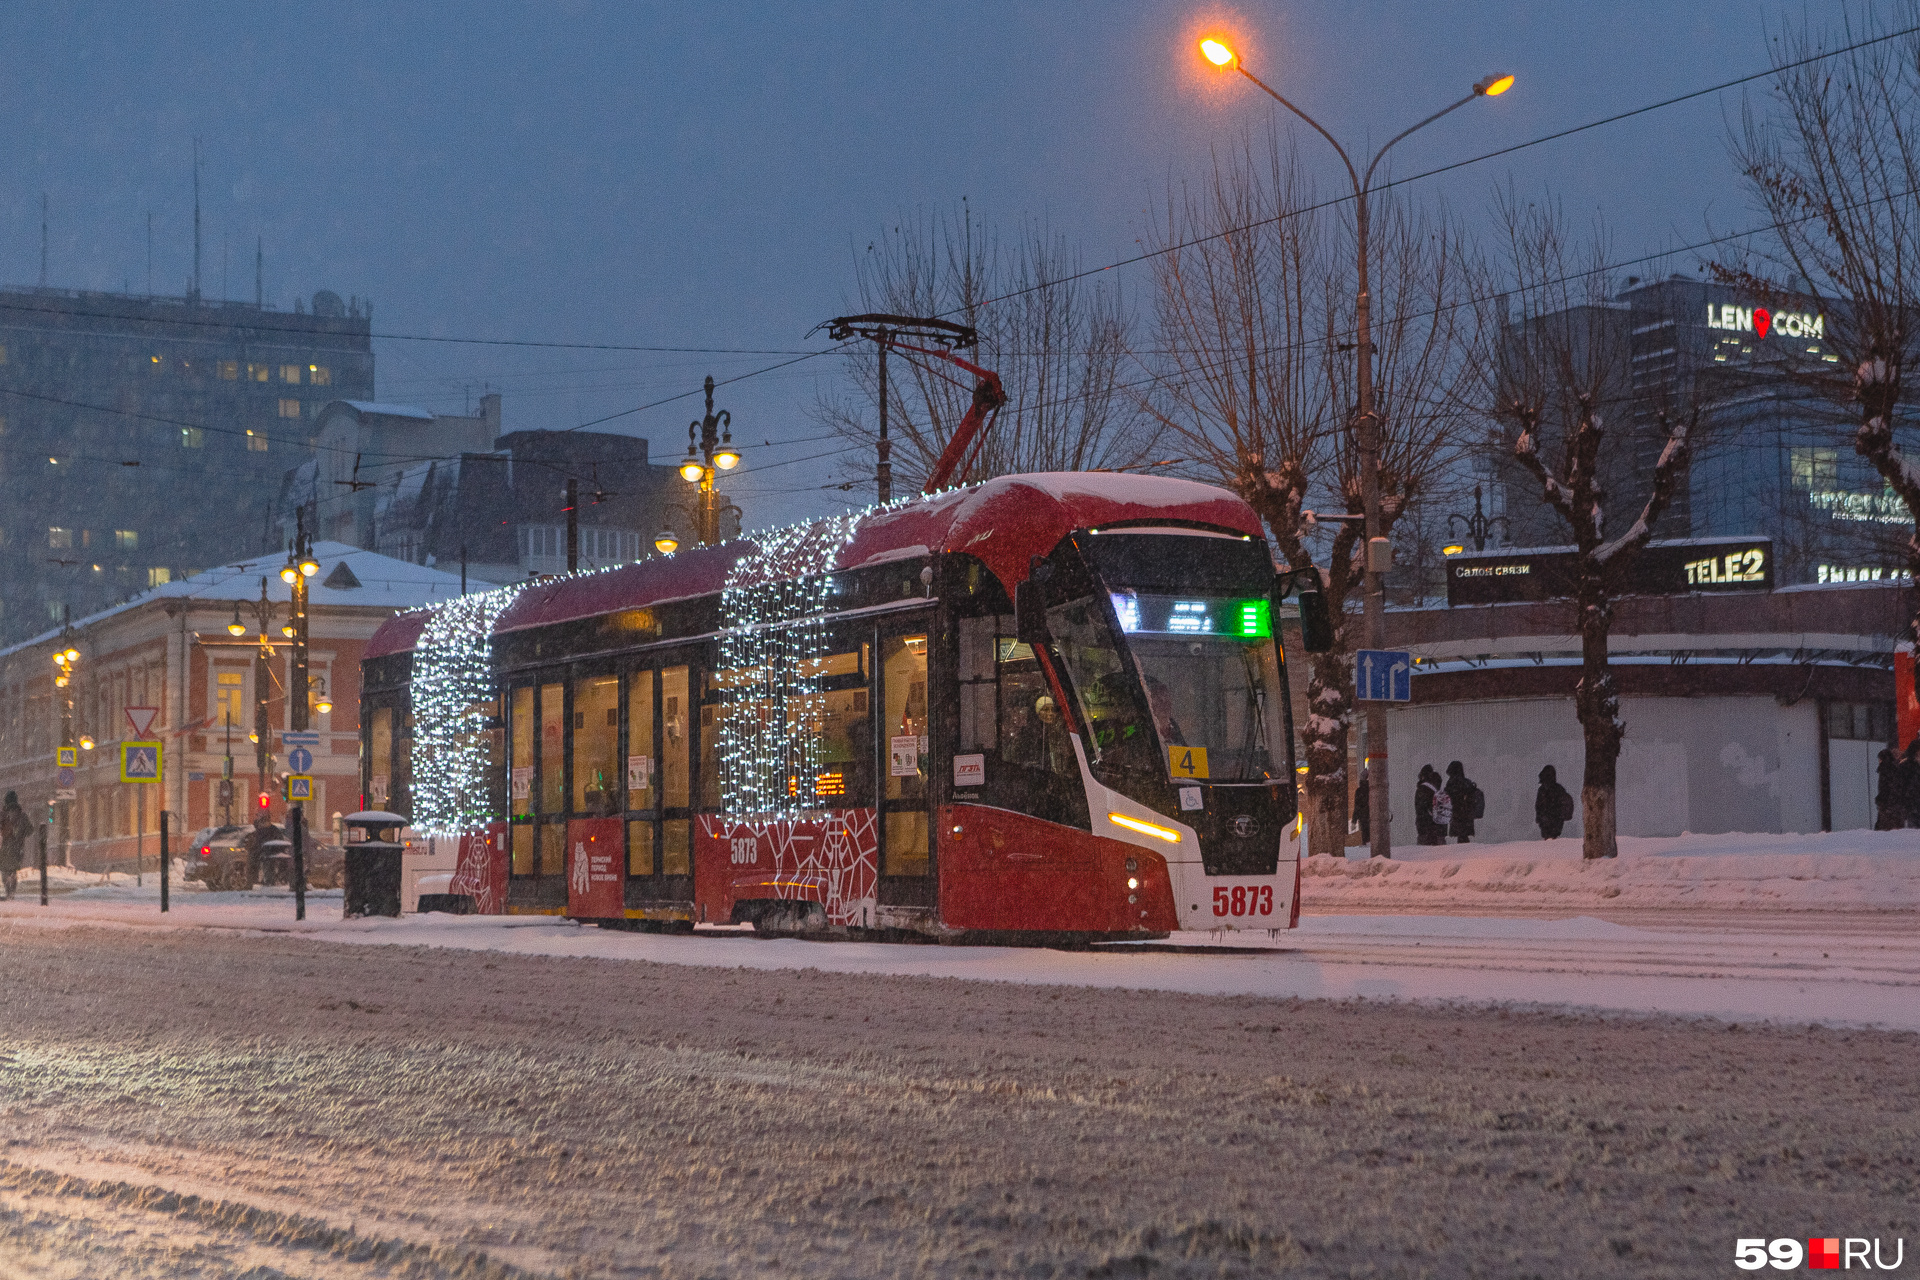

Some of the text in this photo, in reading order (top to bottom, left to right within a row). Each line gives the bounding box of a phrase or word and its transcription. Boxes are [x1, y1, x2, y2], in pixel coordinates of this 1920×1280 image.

[1456, 565, 1530, 577] Салон связи
[1684, 548, 1765, 585] TELE2
[1179, 750, 1196, 775] 4
[730, 837, 757, 864] 5873
[1212, 885, 1273, 917] 5873
